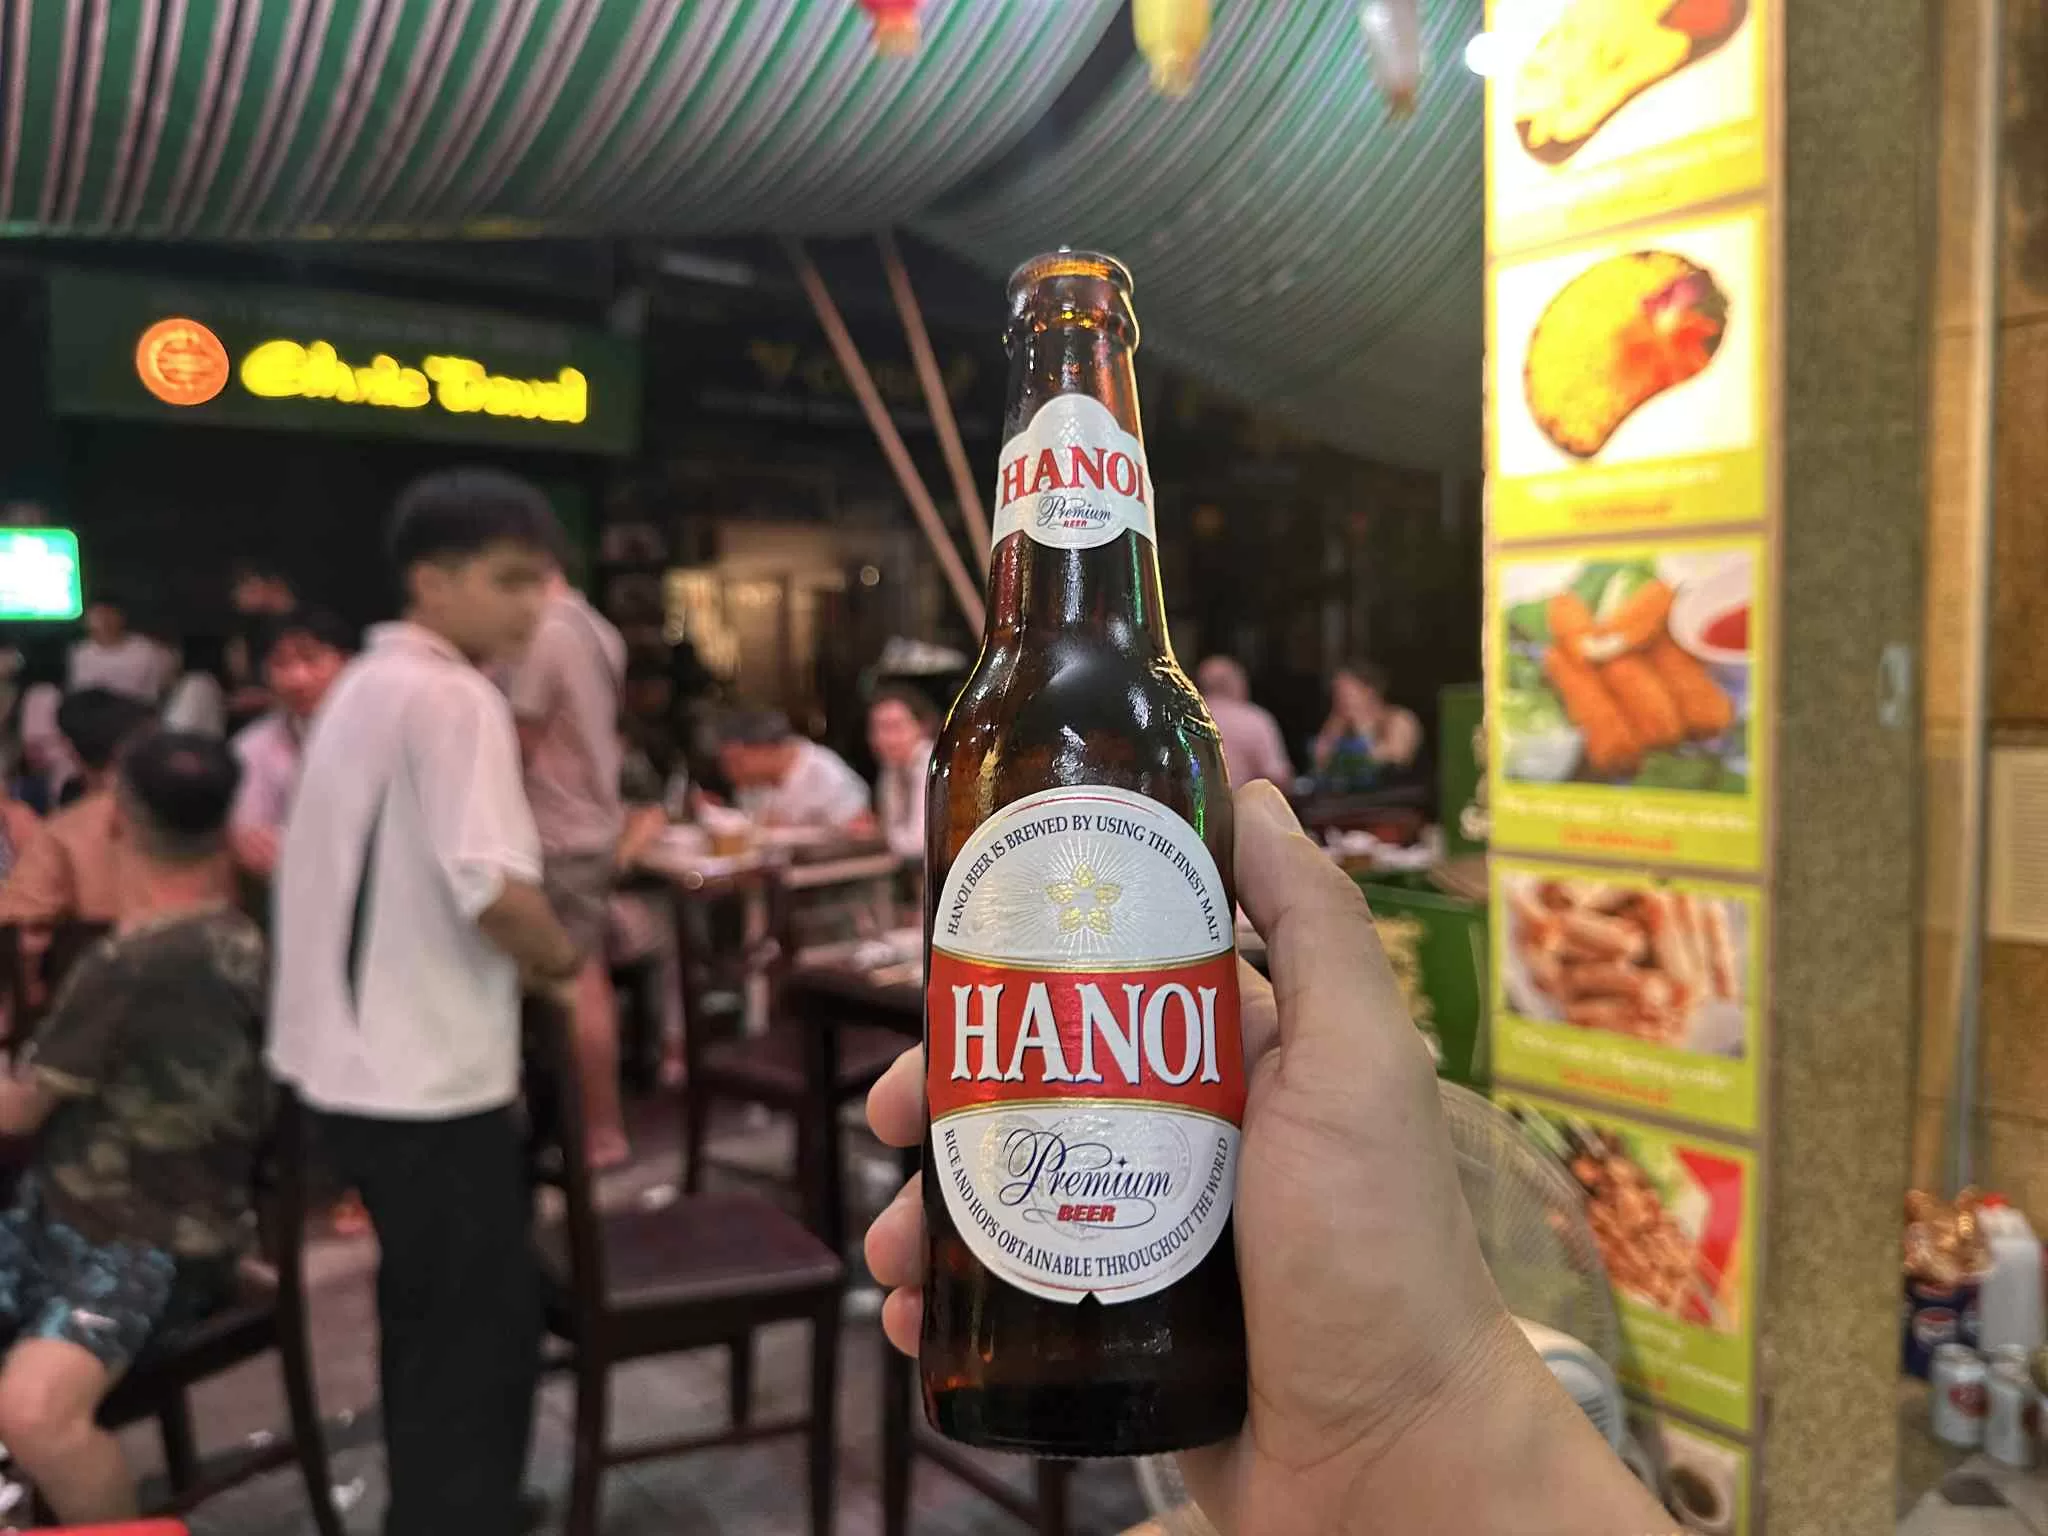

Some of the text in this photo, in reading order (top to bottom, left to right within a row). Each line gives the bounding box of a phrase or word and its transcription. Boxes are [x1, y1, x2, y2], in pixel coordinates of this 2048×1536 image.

[1001, 446, 1146, 510] HANOI
[1037, 496, 1112, 528] Premium
[1063, 520, 1088, 529] BEER
[947, 815, 1220, 942] HANOI BEER IS BREWED BY USING THE FINEST MALT
[951, 982, 1221, 1086] HANOI
[944, 1128, 1229, 1277] RICE AND HOPS OBTAINABLE THROUGHOUT THE WORLD
[1000, 1128, 1173, 1206] Premium
[1057, 1204, 1116, 1222] BEER
